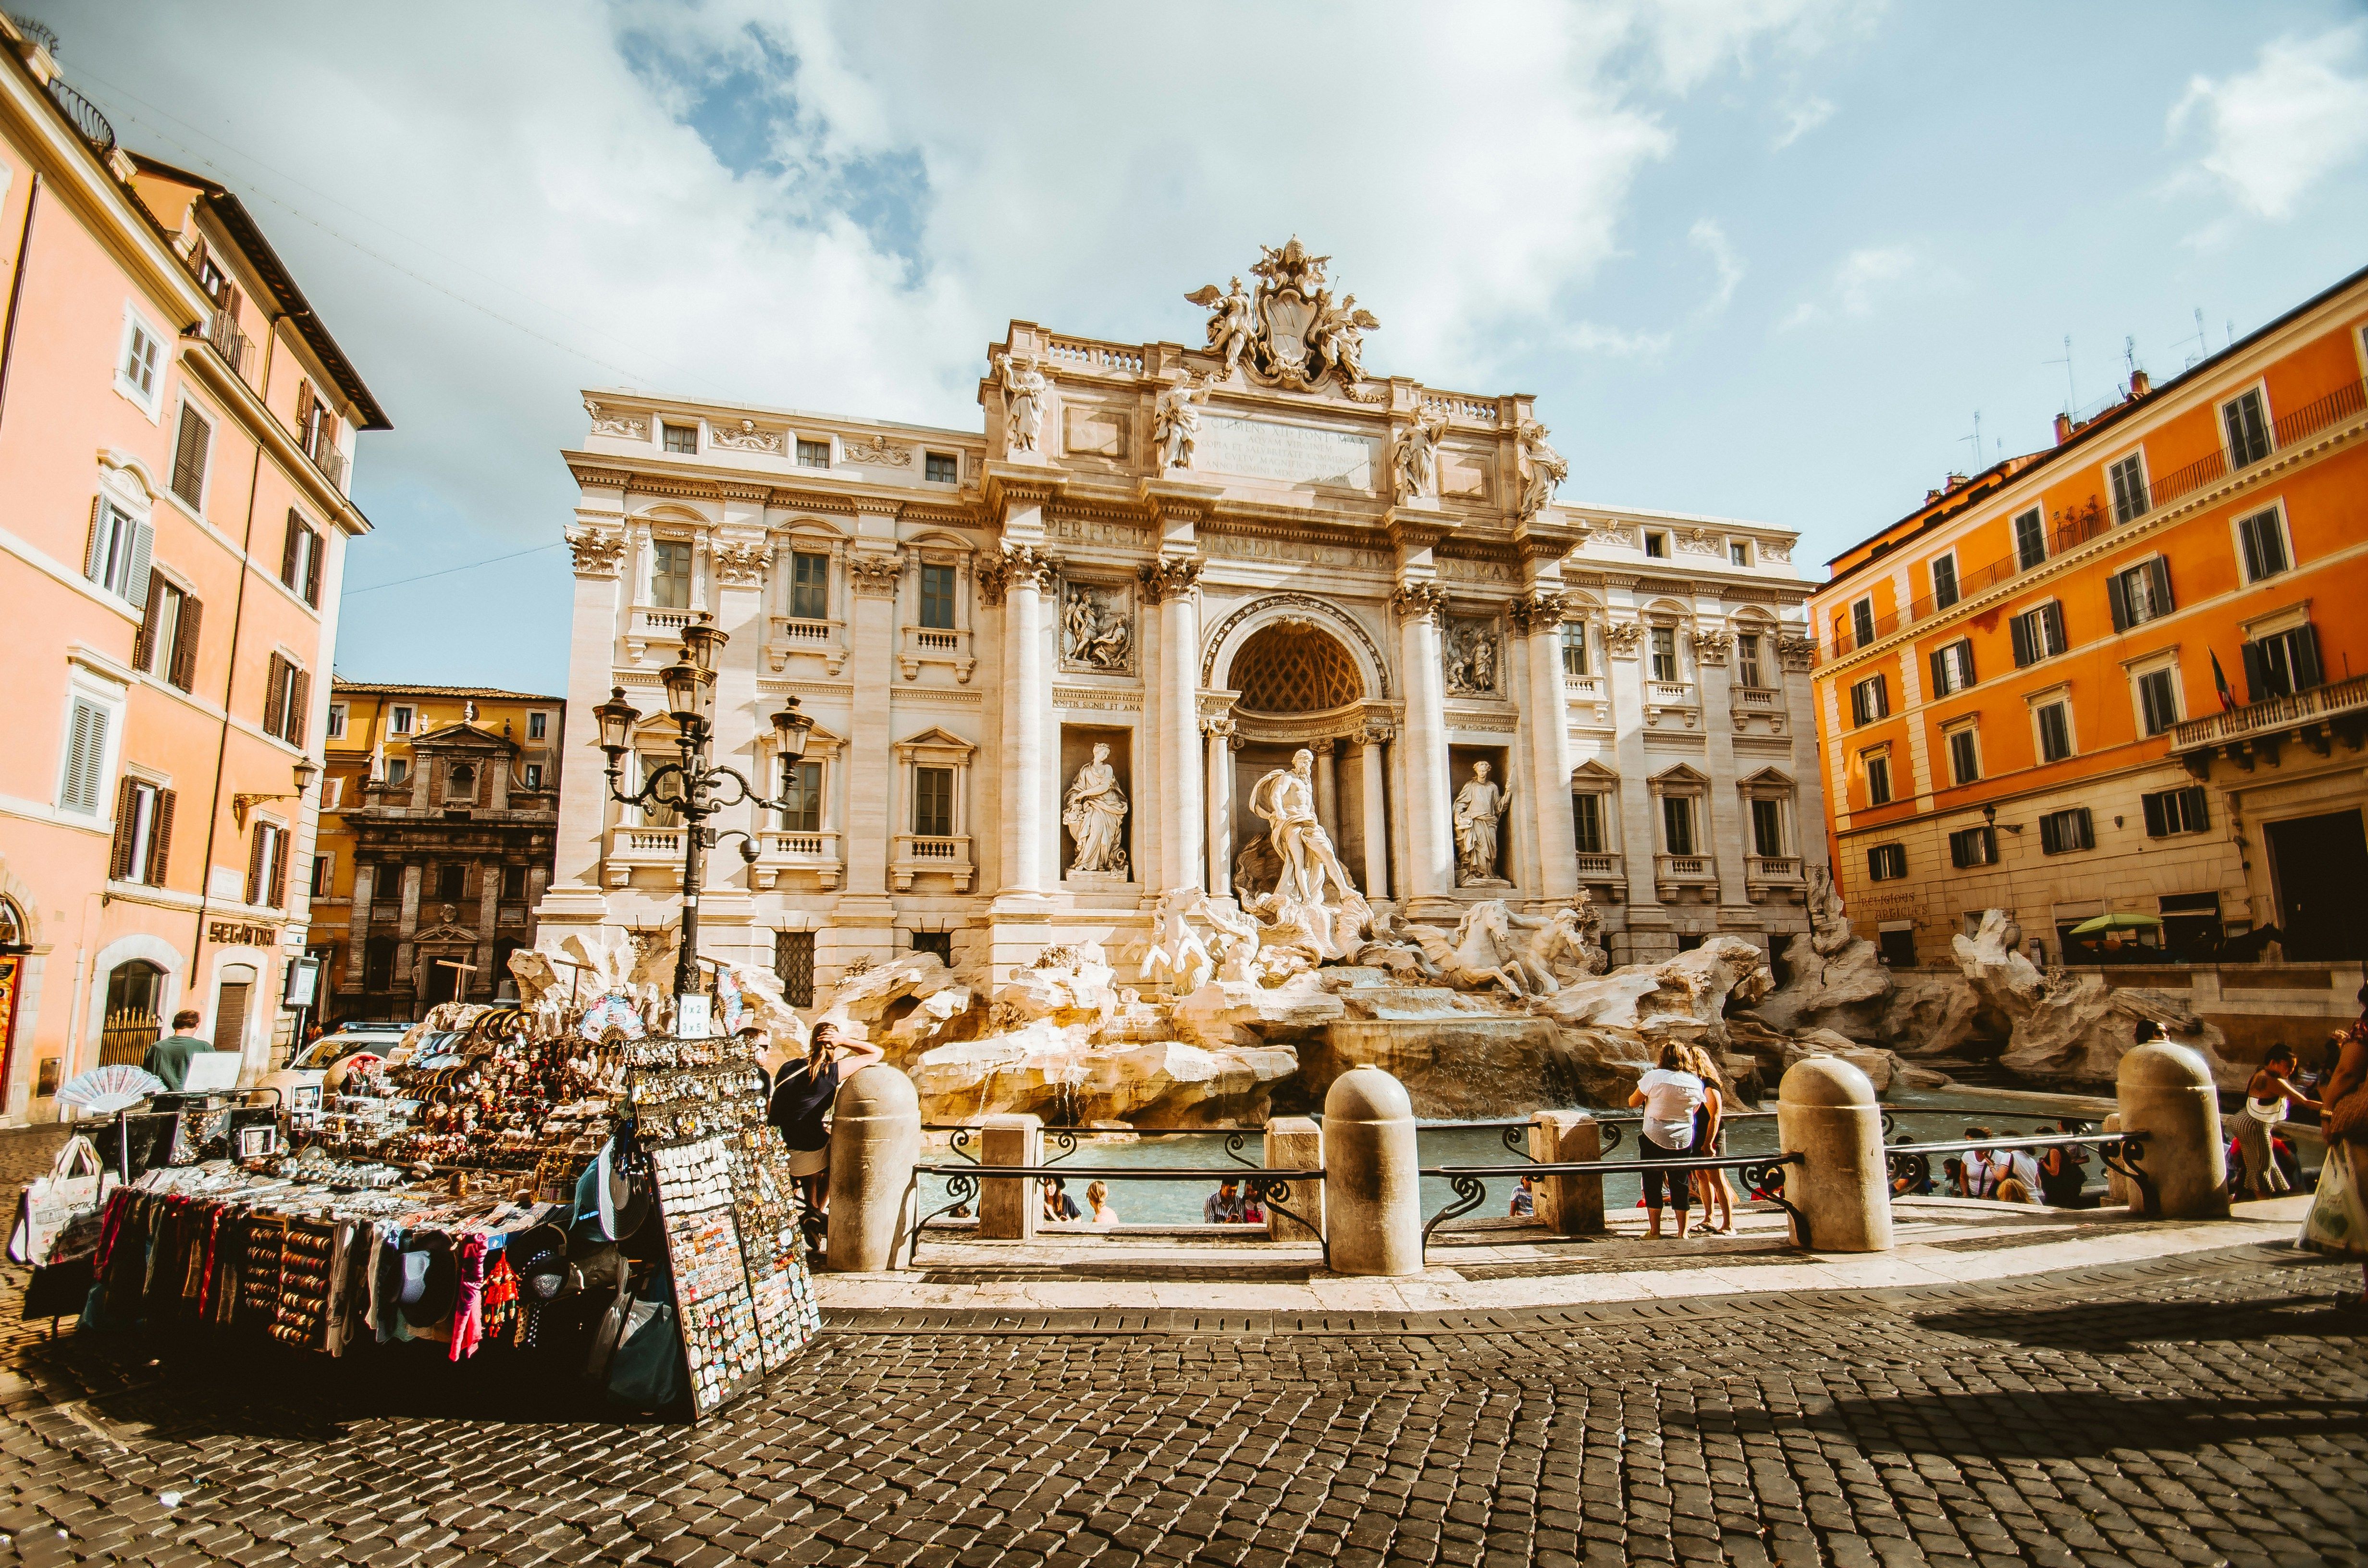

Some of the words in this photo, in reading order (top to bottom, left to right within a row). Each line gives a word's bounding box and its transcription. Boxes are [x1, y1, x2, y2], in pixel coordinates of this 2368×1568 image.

[1211, 419, 1265, 434] CLEMENS
[1201, 440, 1228, 449] COPIA
[1249, 436, 1281, 446] AQVAM
[1287, 441, 1332, 453] VIRGINEM
[1206, 461, 1233, 470] ANNO
[1236, 464, 1270, 474] DOMINI
[1045, 518, 1152, 546] PERFECIT
[1196, 534, 1334, 563] BENEDICTVS
[1053, 699, 1079, 708] POSITIS
[1330, 725, 1345, 734] OPVS
[1347, 721, 1359, 729] CVM
[1861, 892, 1915, 907] RELIGIOUS
[1875, 905, 1928, 919] ARTICLES
[684, 1004, 687, 1014] 1
[696, 1005, 701, 1014] 2
[683, 1023, 687, 1032] 3
[696, 1023, 701, 1032] 5
